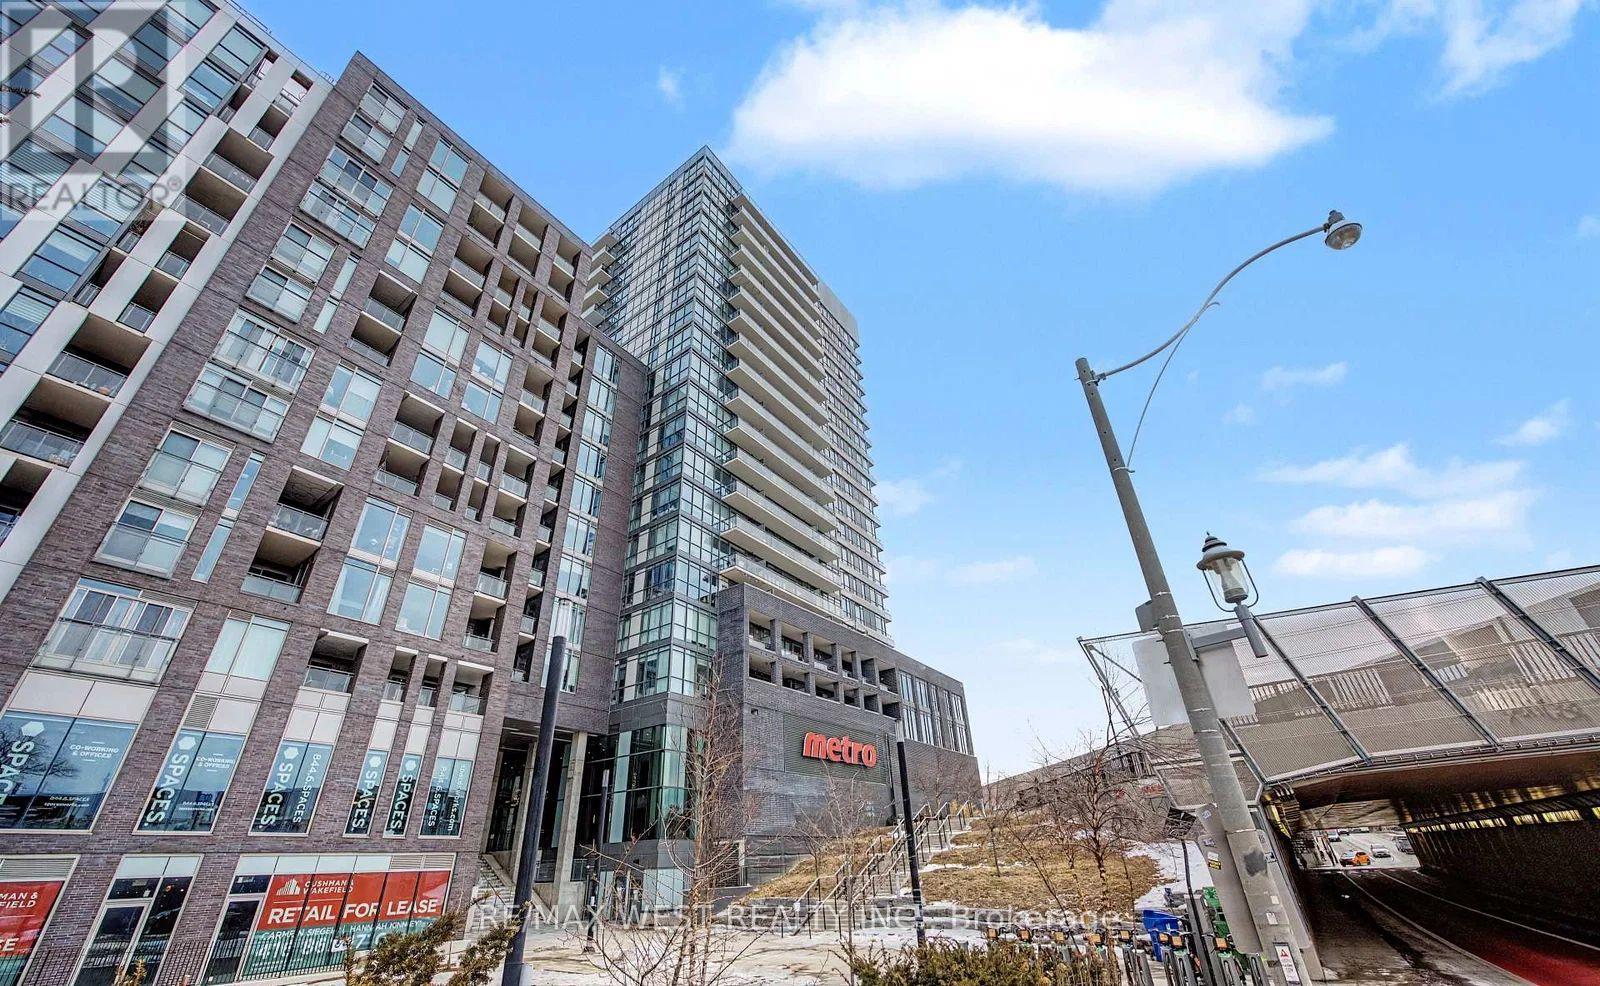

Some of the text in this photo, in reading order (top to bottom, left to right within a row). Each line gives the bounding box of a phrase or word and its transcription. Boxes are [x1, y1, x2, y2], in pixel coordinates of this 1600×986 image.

[803, 731, 876, 768] metro
[304, 879, 348, 888] CUSHMAN
[267, 904, 336, 925] RETAIL
[386, 898, 439, 917] LEASE
